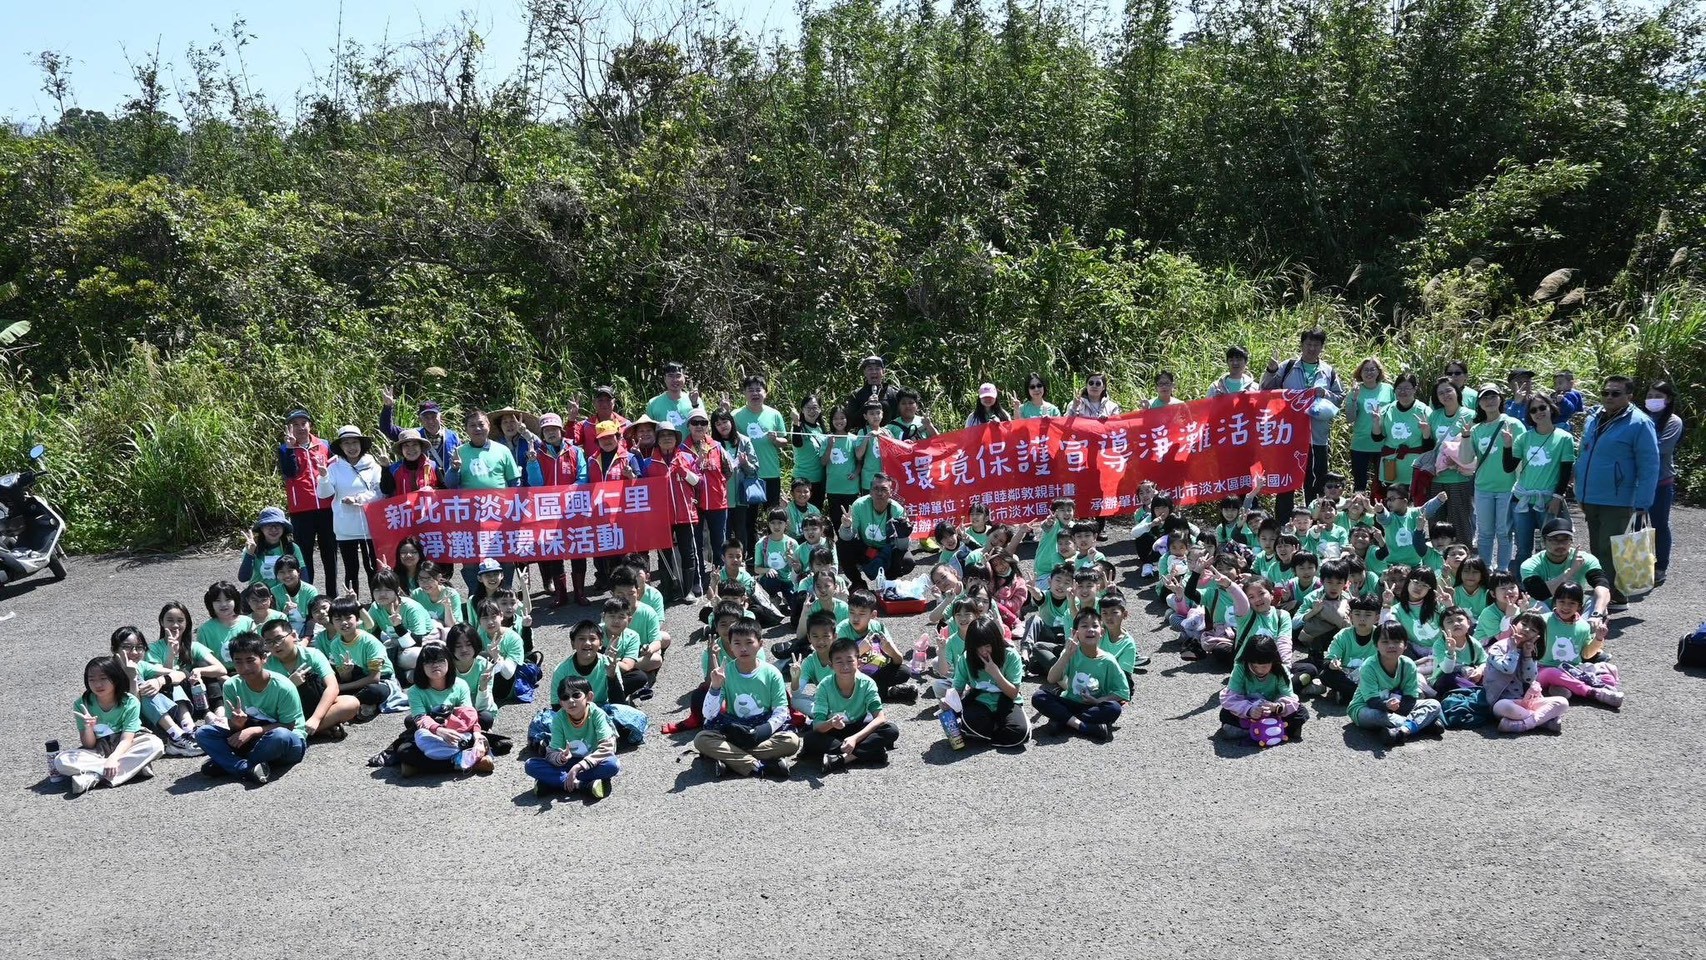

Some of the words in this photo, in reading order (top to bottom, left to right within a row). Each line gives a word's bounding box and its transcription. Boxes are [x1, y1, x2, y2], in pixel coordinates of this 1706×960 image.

[902, 409, 1294, 490] 環境保護宣導淨灘活動
[384, 485, 652, 530] 新北市淡水區興仁里
[1091, 473, 1293, 510] 承辦單位北市淡水區興國小
[420, 523, 625, 559] 淨灘暨環保活動
